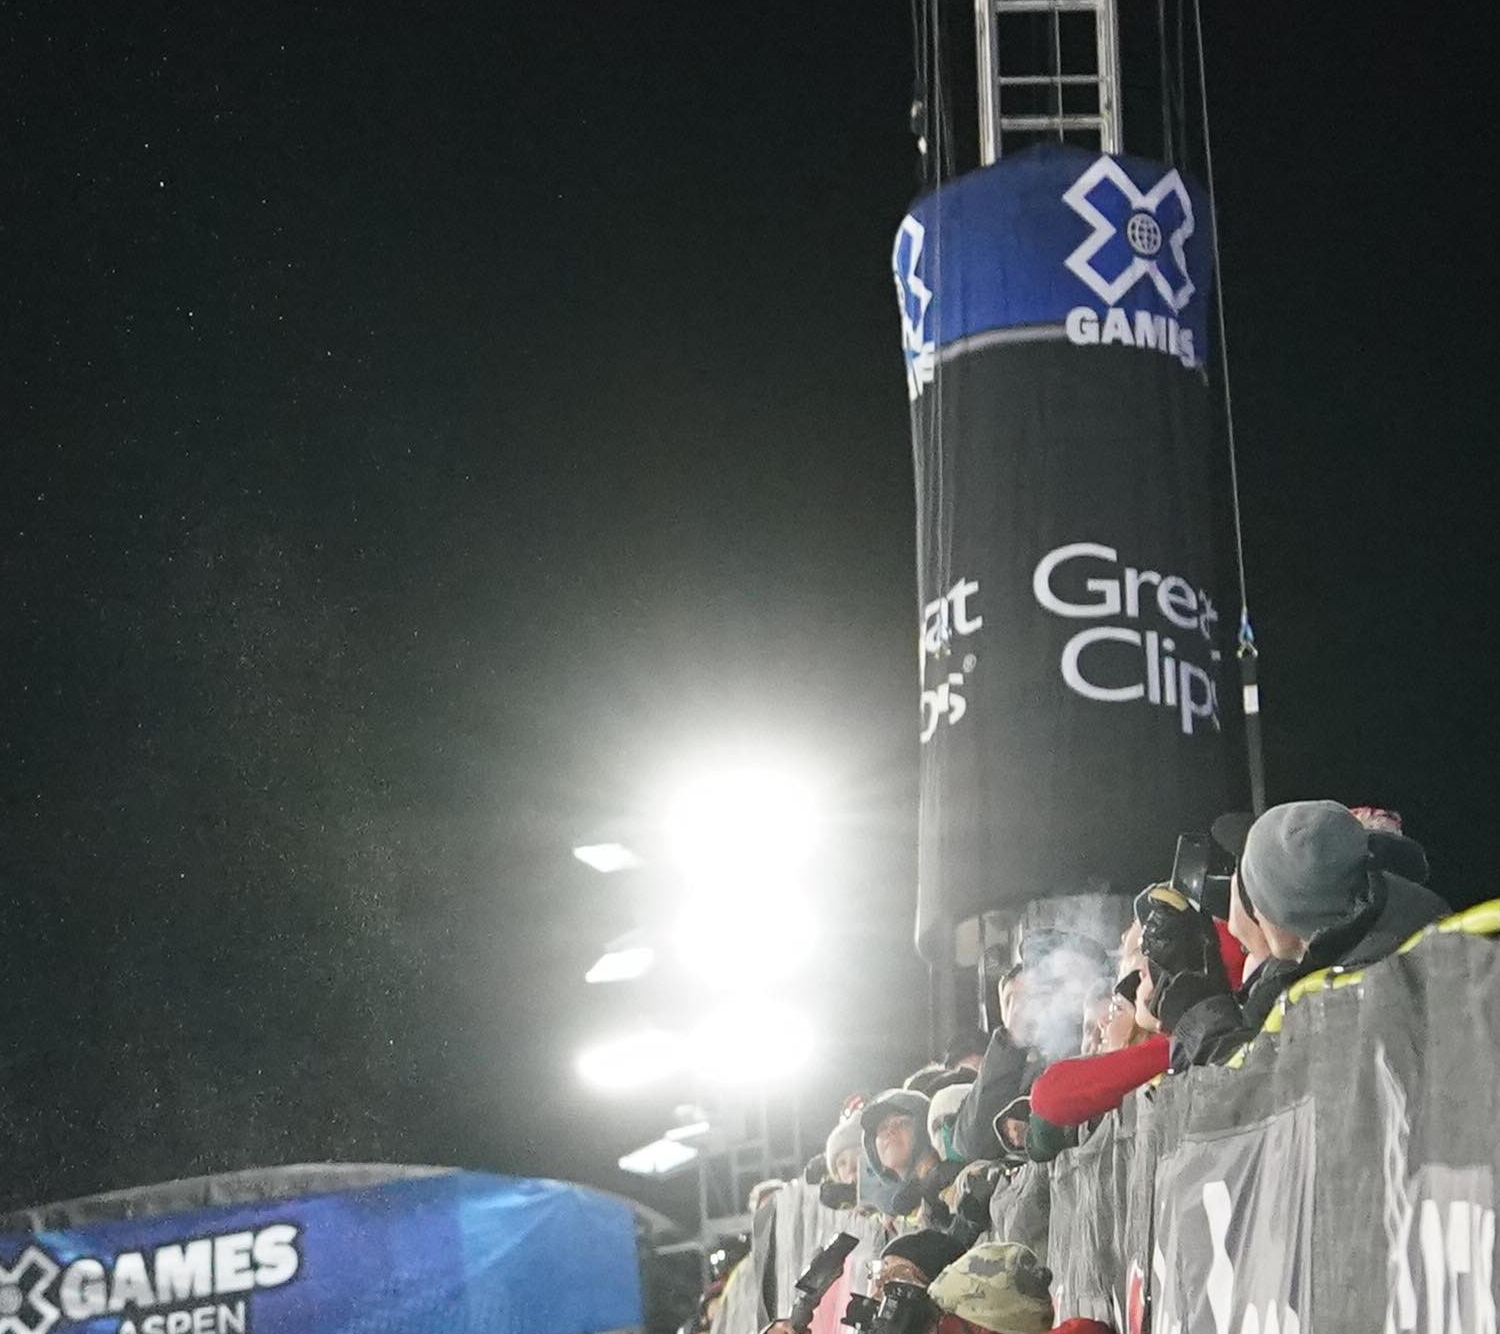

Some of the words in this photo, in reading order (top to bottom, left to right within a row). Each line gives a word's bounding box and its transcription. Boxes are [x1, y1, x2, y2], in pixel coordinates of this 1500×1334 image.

[1032, 542, 1218, 639] Gre
[1061, 626, 1222, 735] Clip
[58, 1223, 300, 1322] GAMES
